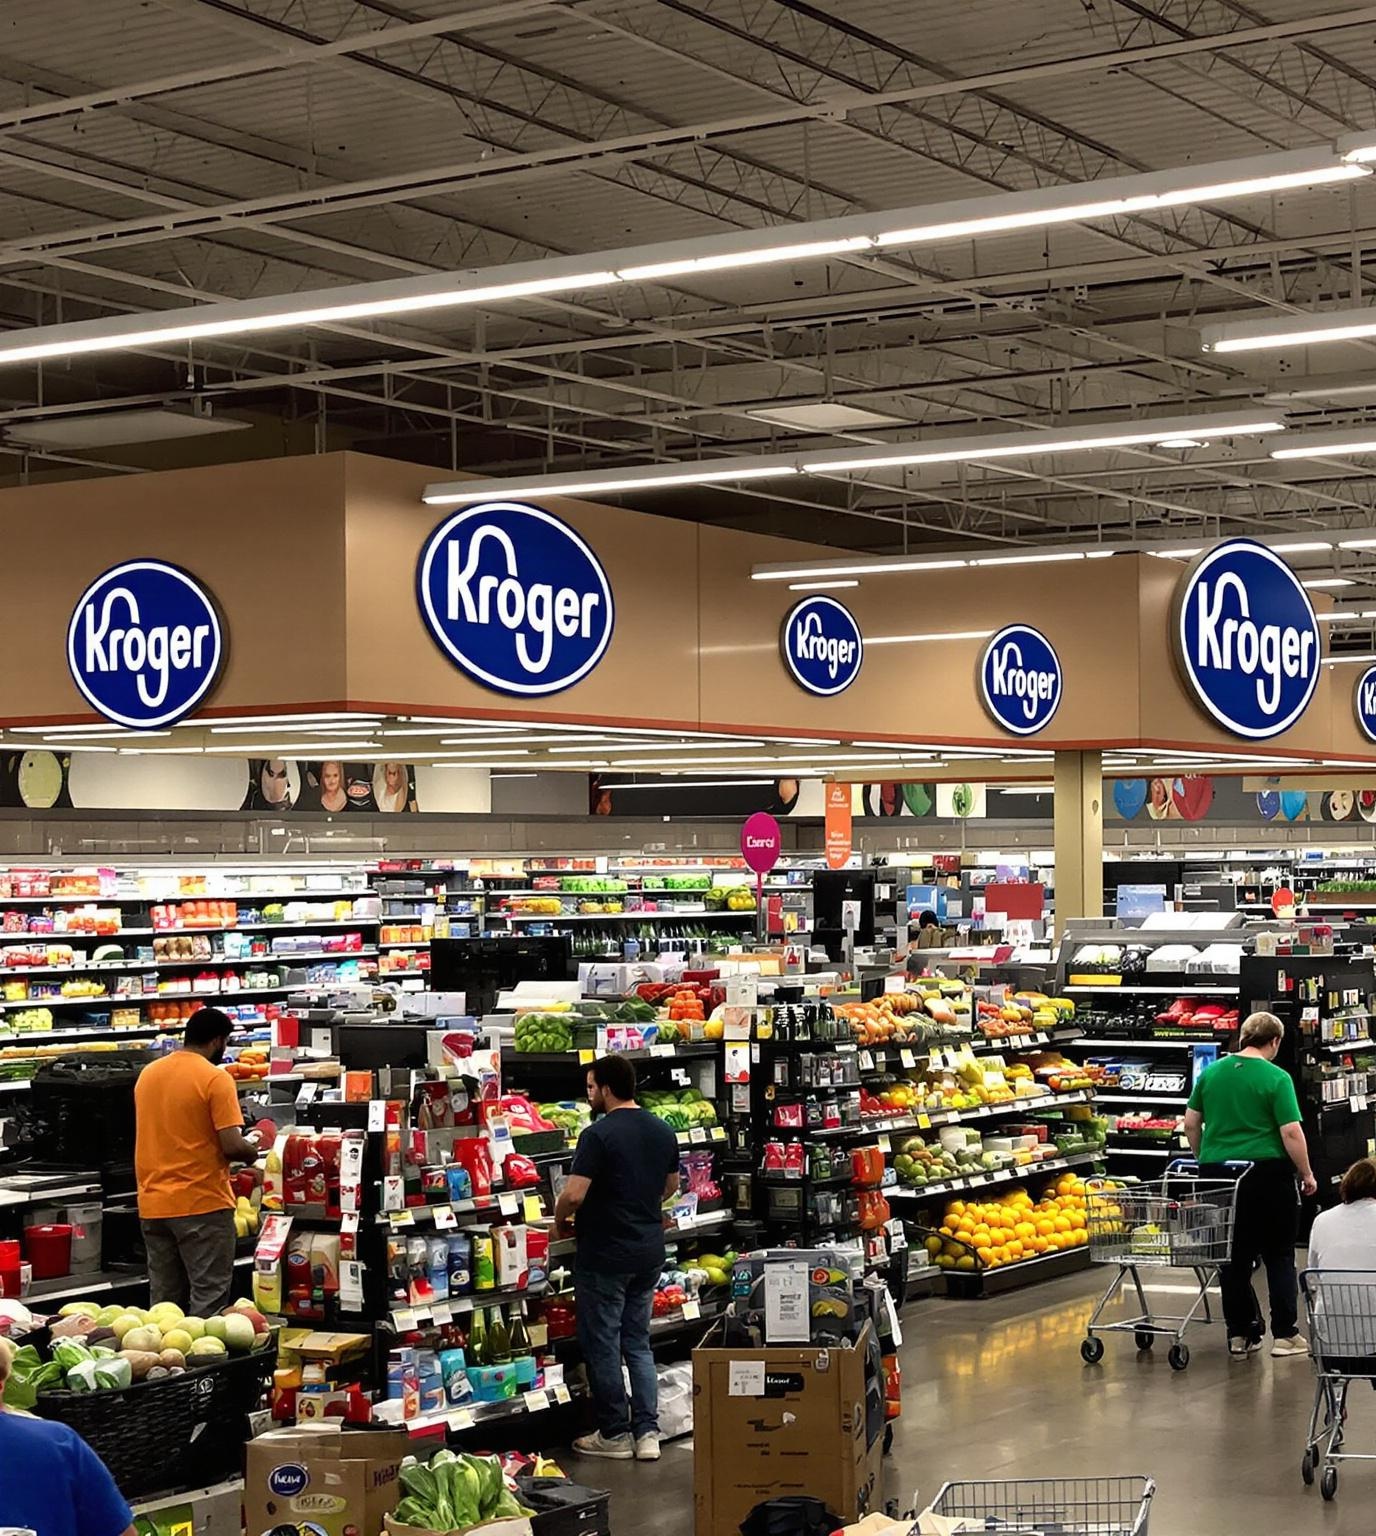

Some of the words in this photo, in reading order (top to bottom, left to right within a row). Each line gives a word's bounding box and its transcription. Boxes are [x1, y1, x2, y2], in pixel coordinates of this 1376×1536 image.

[85, 587, 210, 708] Kroger
[447, 524, 599, 674] Kroger
[796, 612, 856, 679] Kroger
[1198, 571, 1314, 715] Kroger
[992, 642, 1056, 720] Kroger
